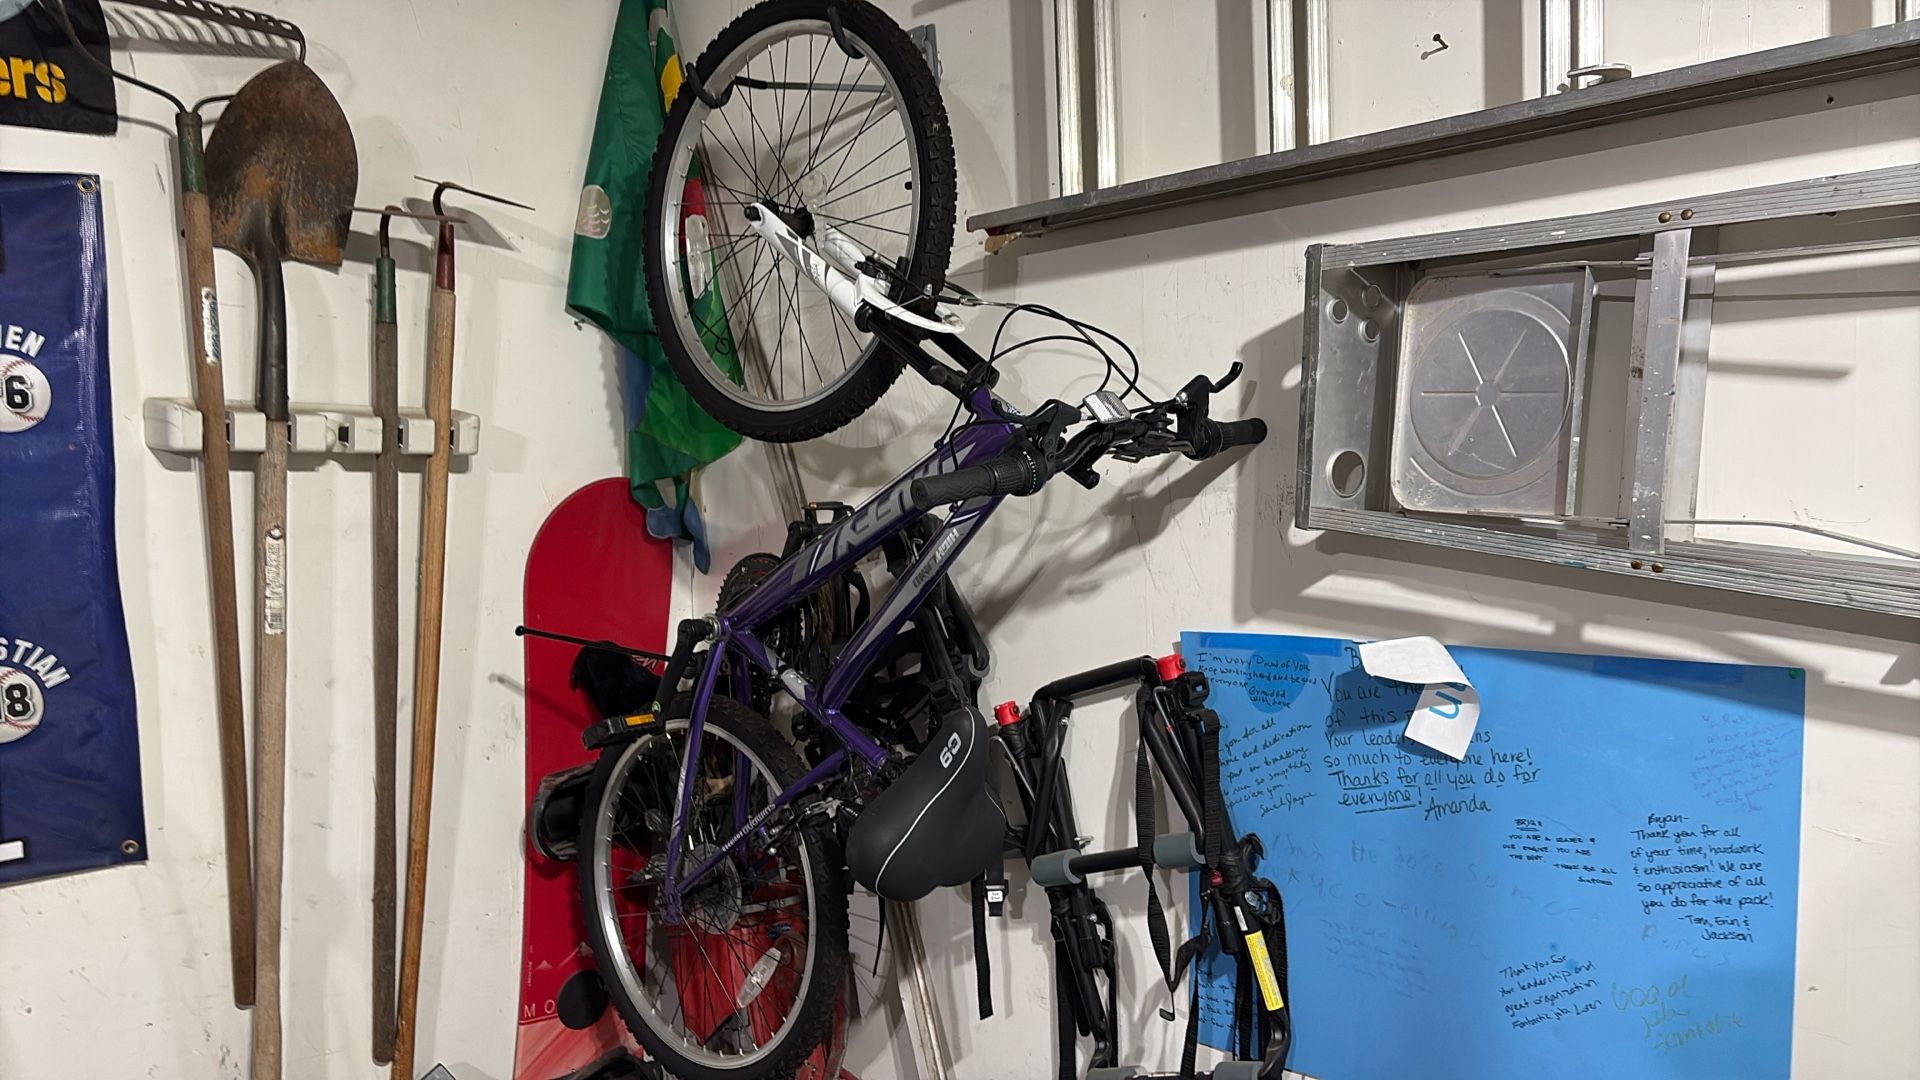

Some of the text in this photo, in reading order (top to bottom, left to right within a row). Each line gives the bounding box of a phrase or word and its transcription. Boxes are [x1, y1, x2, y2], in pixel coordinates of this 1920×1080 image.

[1321, 671, 1353, 703] You
[1357, 685, 1380, 701] are
[1325, 708, 1345, 729] of
[1360, 706, 1397, 725] this
[1242, 727, 1259, 739] for
[1261, 717, 1277, 730] all
[1325, 730, 1353, 749] Your
[1242, 744, 1258, 759] and
[1323, 754, 1340, 768] so
[1348, 750, 1390, 766] much
[1393, 753, 1412, 766] to
[1490, 748, 1533, 766] here!
[1328, 765, 1541, 788] Thanks for all you do for
[1338, 787, 1422, 807] everyone!
[1424, 794, 1492, 821] Amanda
[1630, 824, 1741, 843] Thank you for all
[1630, 847, 1645, 858] of
[1645, 848, 1671, 863] your
[1678, 845, 1707, 859] time,
[1643, 860, 1715, 875] enthusiasm!
[1718, 861, 1735, 871] We
[1739, 861, 1763, 871] are
[1654, 877, 1723, 895] appreciative
[1728, 875, 1742, 887] of
[1745, 876, 1766, 886] all
[1641, 891, 1774, 915] you do for the pack!
[1714, 916, 1741, 927] Erin
[1701, 928, 1753, 943] Jackson
[1498, 962, 1532, 979] Thank
[1531, 960, 1549, 972] you
[1517, 970, 1572, 991] leadership
[1574, 960, 1596, 974] and
[1504, 998, 1530, 1018] great
